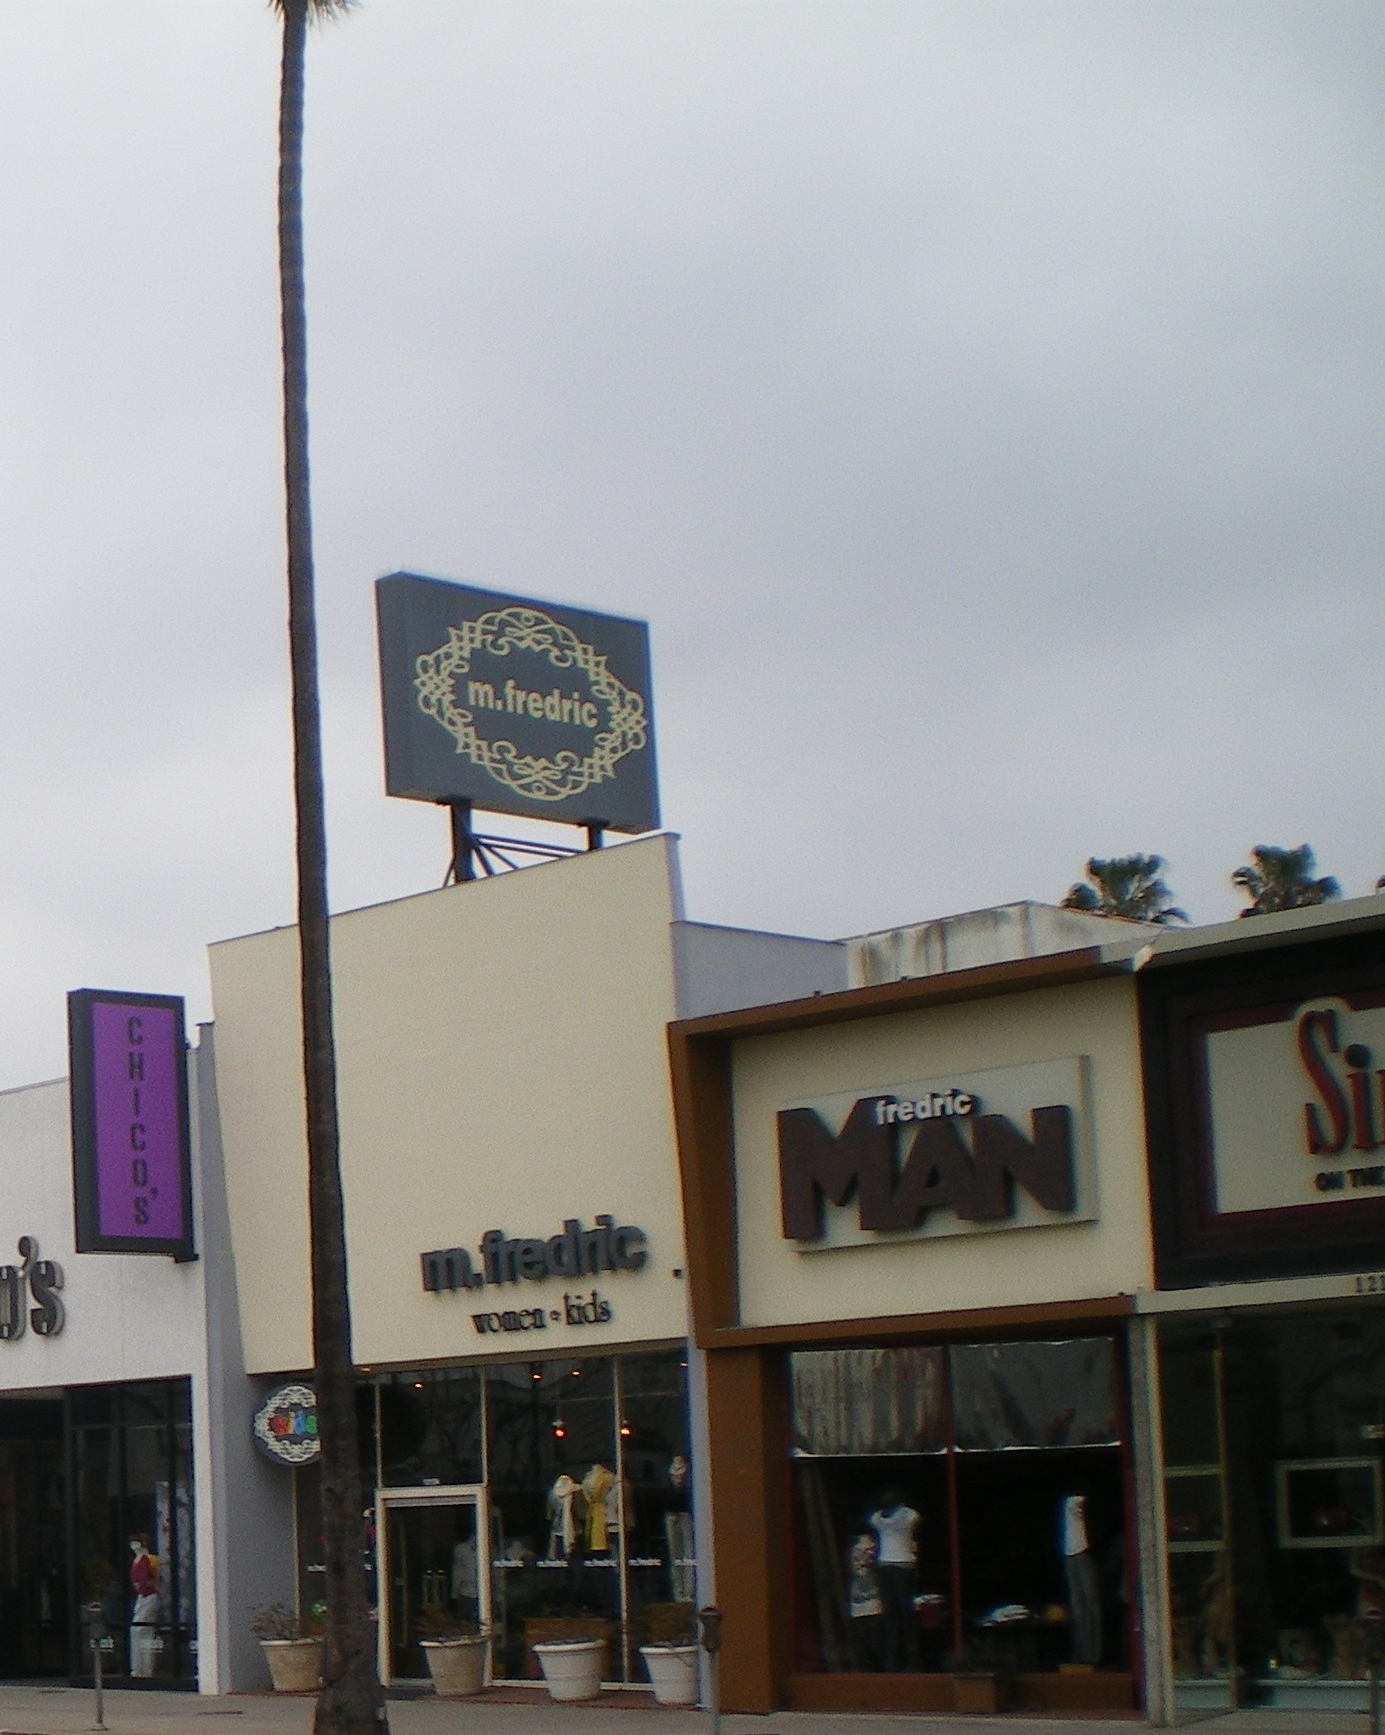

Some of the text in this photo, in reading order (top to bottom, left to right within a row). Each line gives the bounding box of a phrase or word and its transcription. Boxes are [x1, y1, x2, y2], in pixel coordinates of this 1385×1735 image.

[468, 679, 598, 727] m.fredric
[876, 1089, 975, 1125] fredric
[777, 1095, 1075, 1240] MAN
[1316, 1171, 1344, 1192] ON
[420, 1214, 648, 1292] m.fredric
[471, 1289, 612, 1334] women kids
